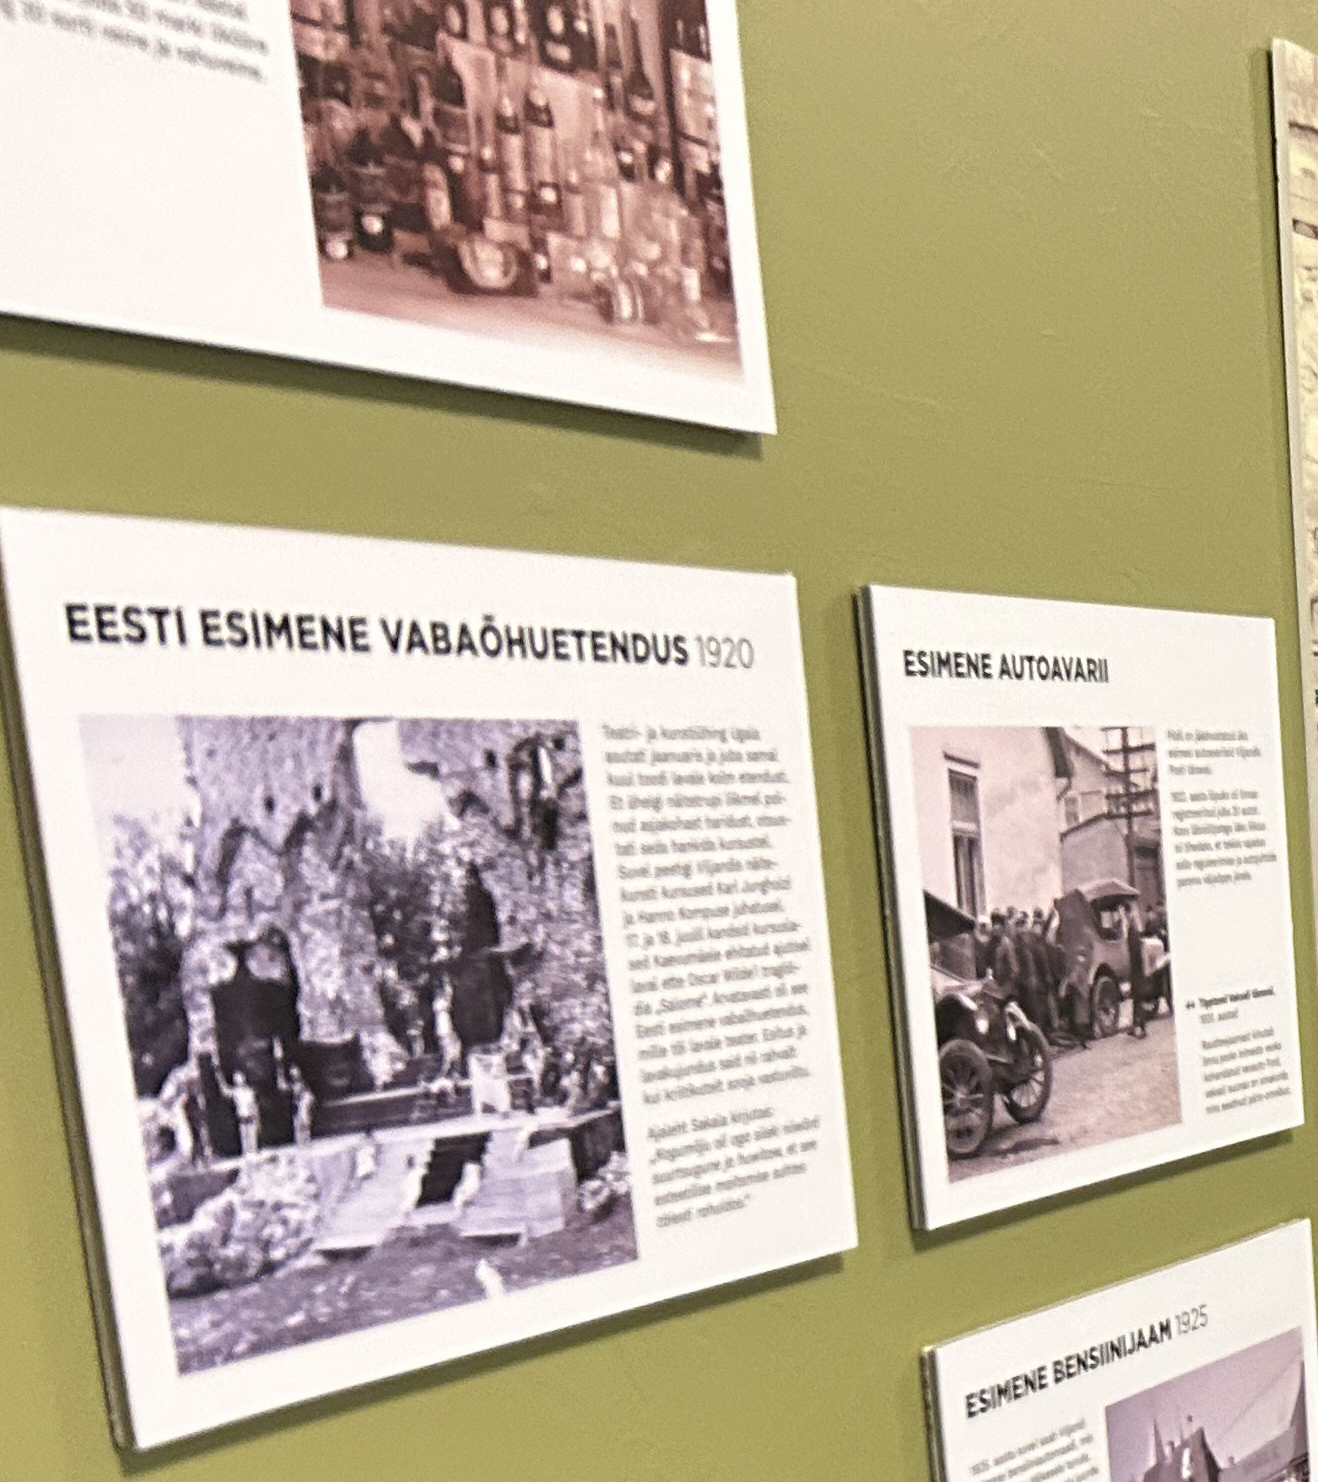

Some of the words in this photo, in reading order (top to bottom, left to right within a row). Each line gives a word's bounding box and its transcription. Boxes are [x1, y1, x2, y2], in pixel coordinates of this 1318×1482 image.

[64, 603, 188, 646] EESTI
[199, 608, 370, 653] ESIMENE
[380, 612, 689, 668] VABAÕHUETENDUS
[697, 633, 757, 670] 1920
[902, 648, 994, 679] ESIMENE
[999, 653, 1110, 684] AUTOAVARII
[965, 1365, 1050, 1419] ESIMENE
[1052, 1317, 1174, 1385] BENSIINIJAAM
[1174, 1303, 1209, 1337] 1925
